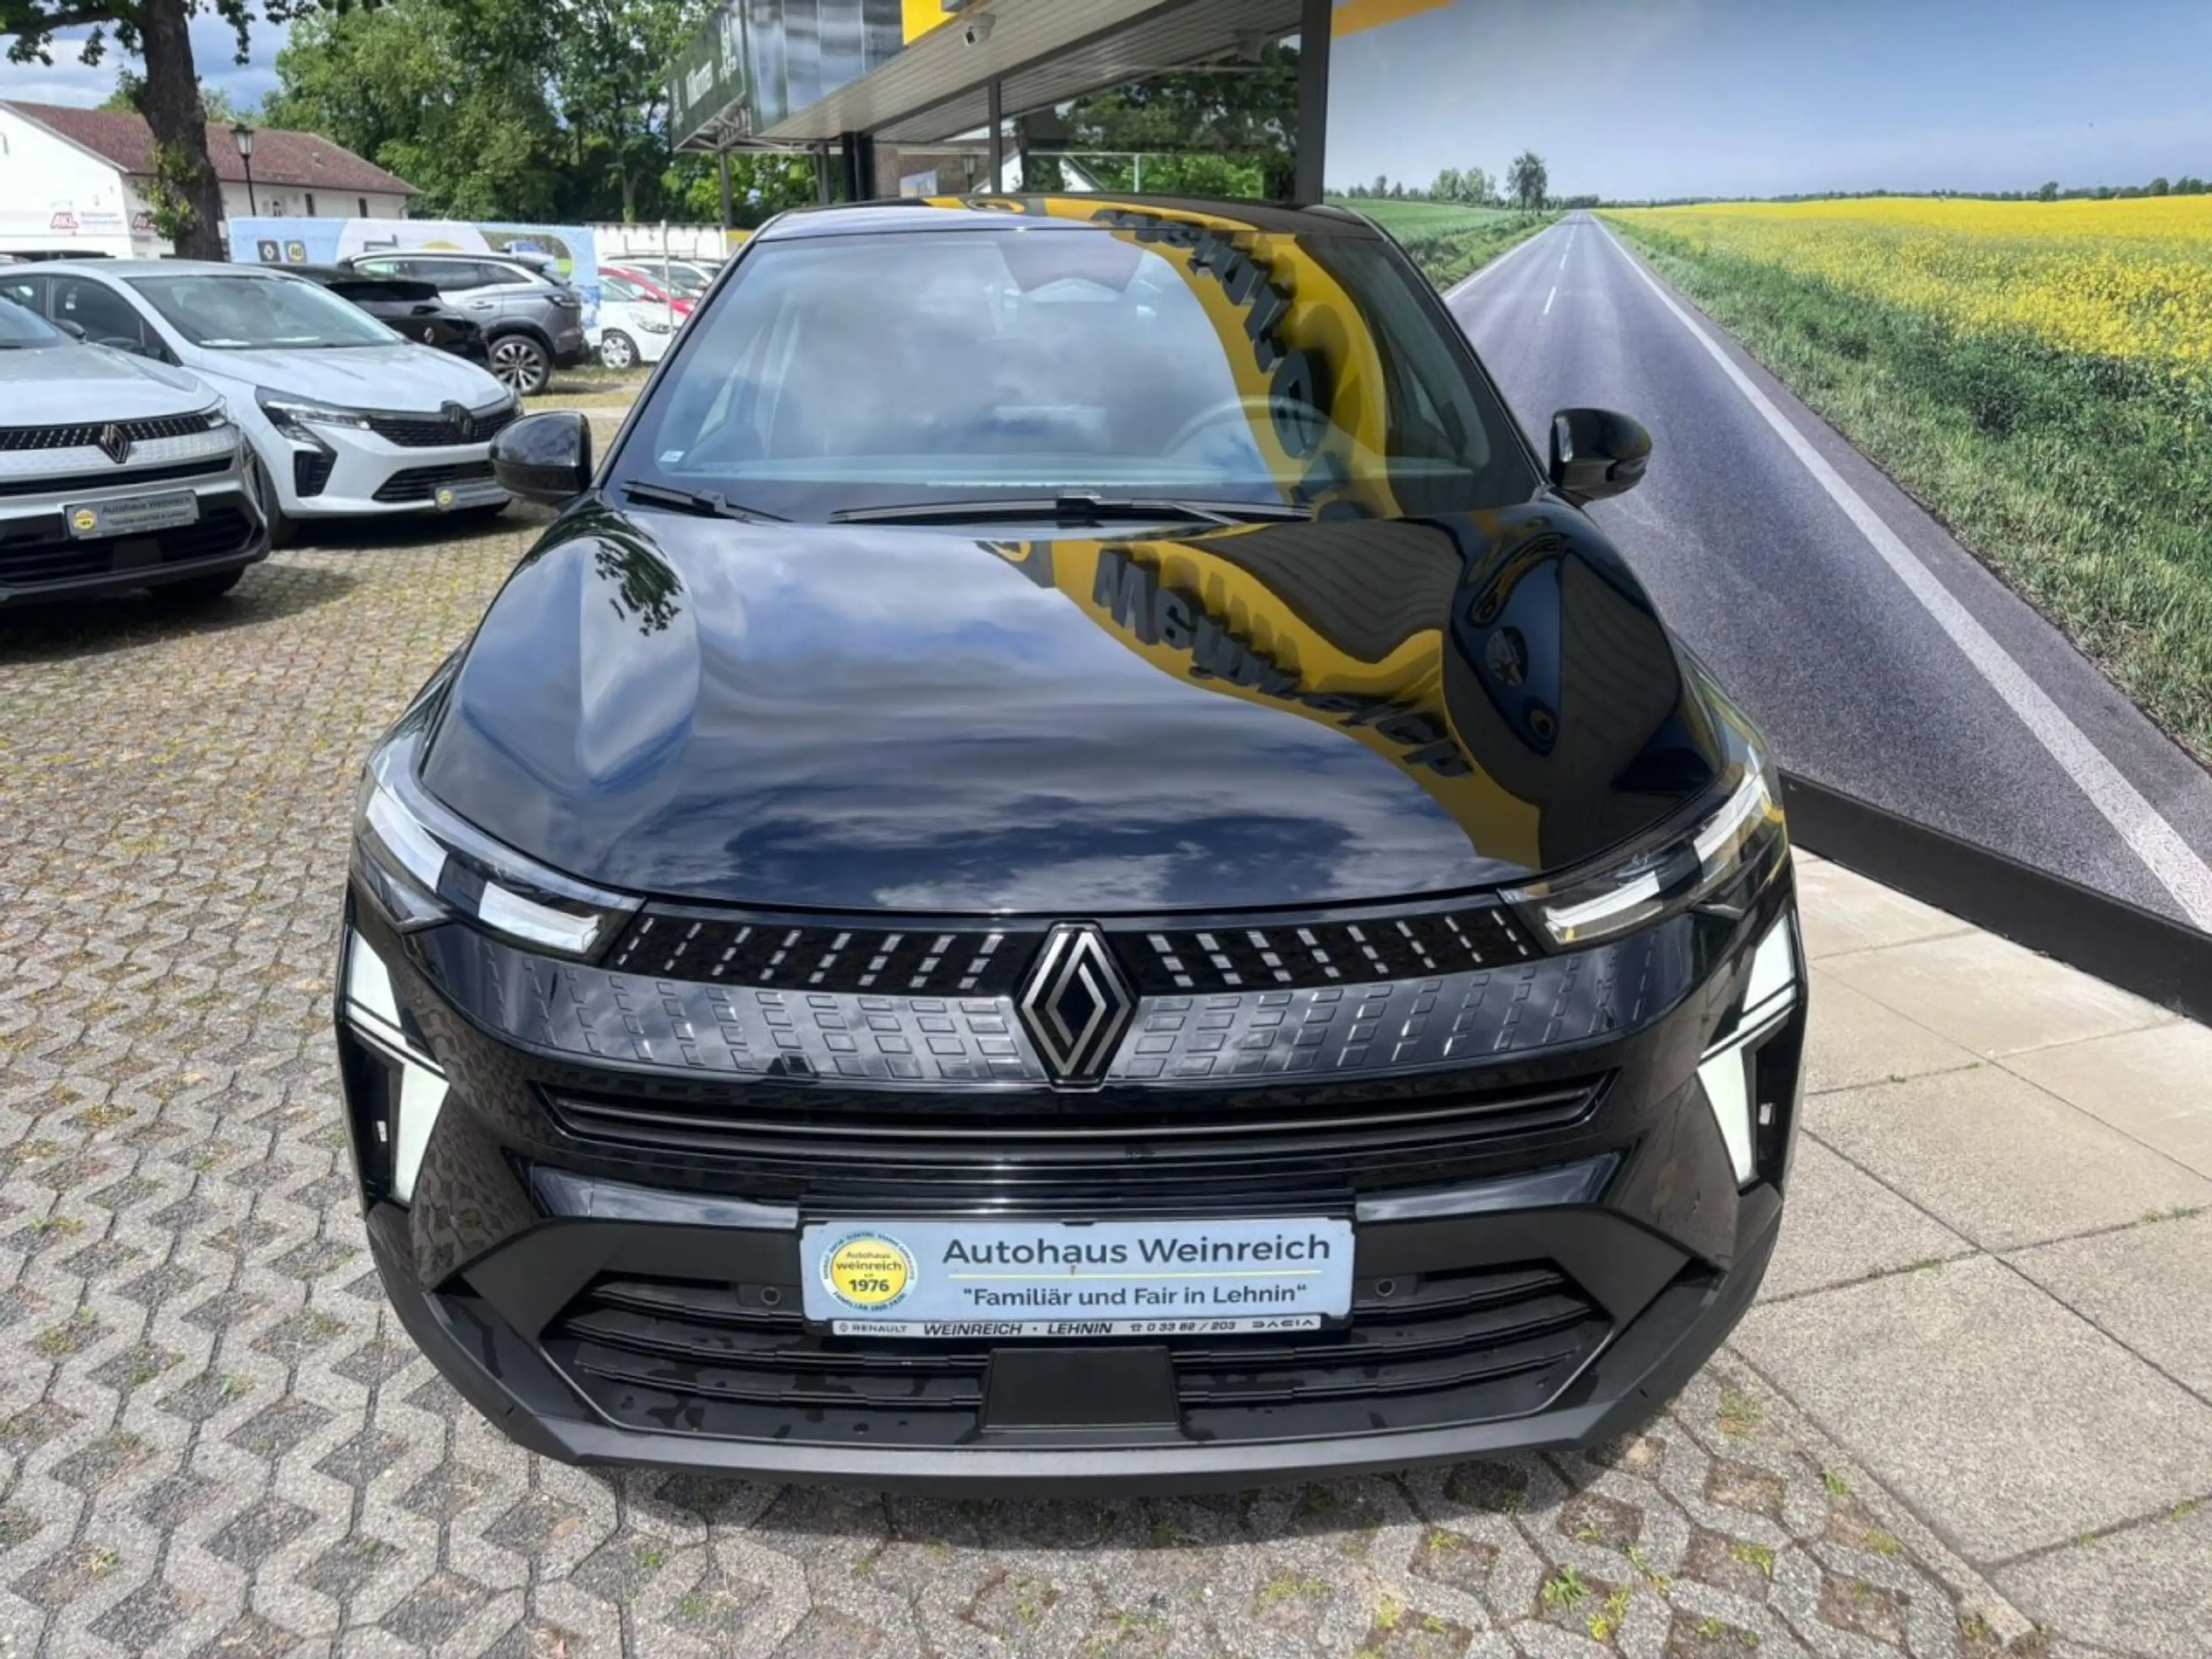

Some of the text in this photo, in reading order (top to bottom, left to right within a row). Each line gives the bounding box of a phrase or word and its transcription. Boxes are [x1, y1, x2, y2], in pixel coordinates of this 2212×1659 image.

[846, 1251, 891, 1259] Autohaus
[942, 1238, 1128, 1264] Autohaus
[1138, 1234, 1330, 1263] Weinreich
[836, 1260, 902, 1271] weinreich
[849, 1279, 890, 1292] 1976
[963, 1287, 1073, 1306] "Familiär
[1078, 1287, 1126, 1306] und
[1134, 1287, 1178, 1305] Fair
[1184, 1286, 1206, 1304] in
[851, 1324, 908, 1334] RENAULT
[923, 1322, 1022, 1336] WEINREICH
[1047, 1321, 1113, 1335] LEHNIN
